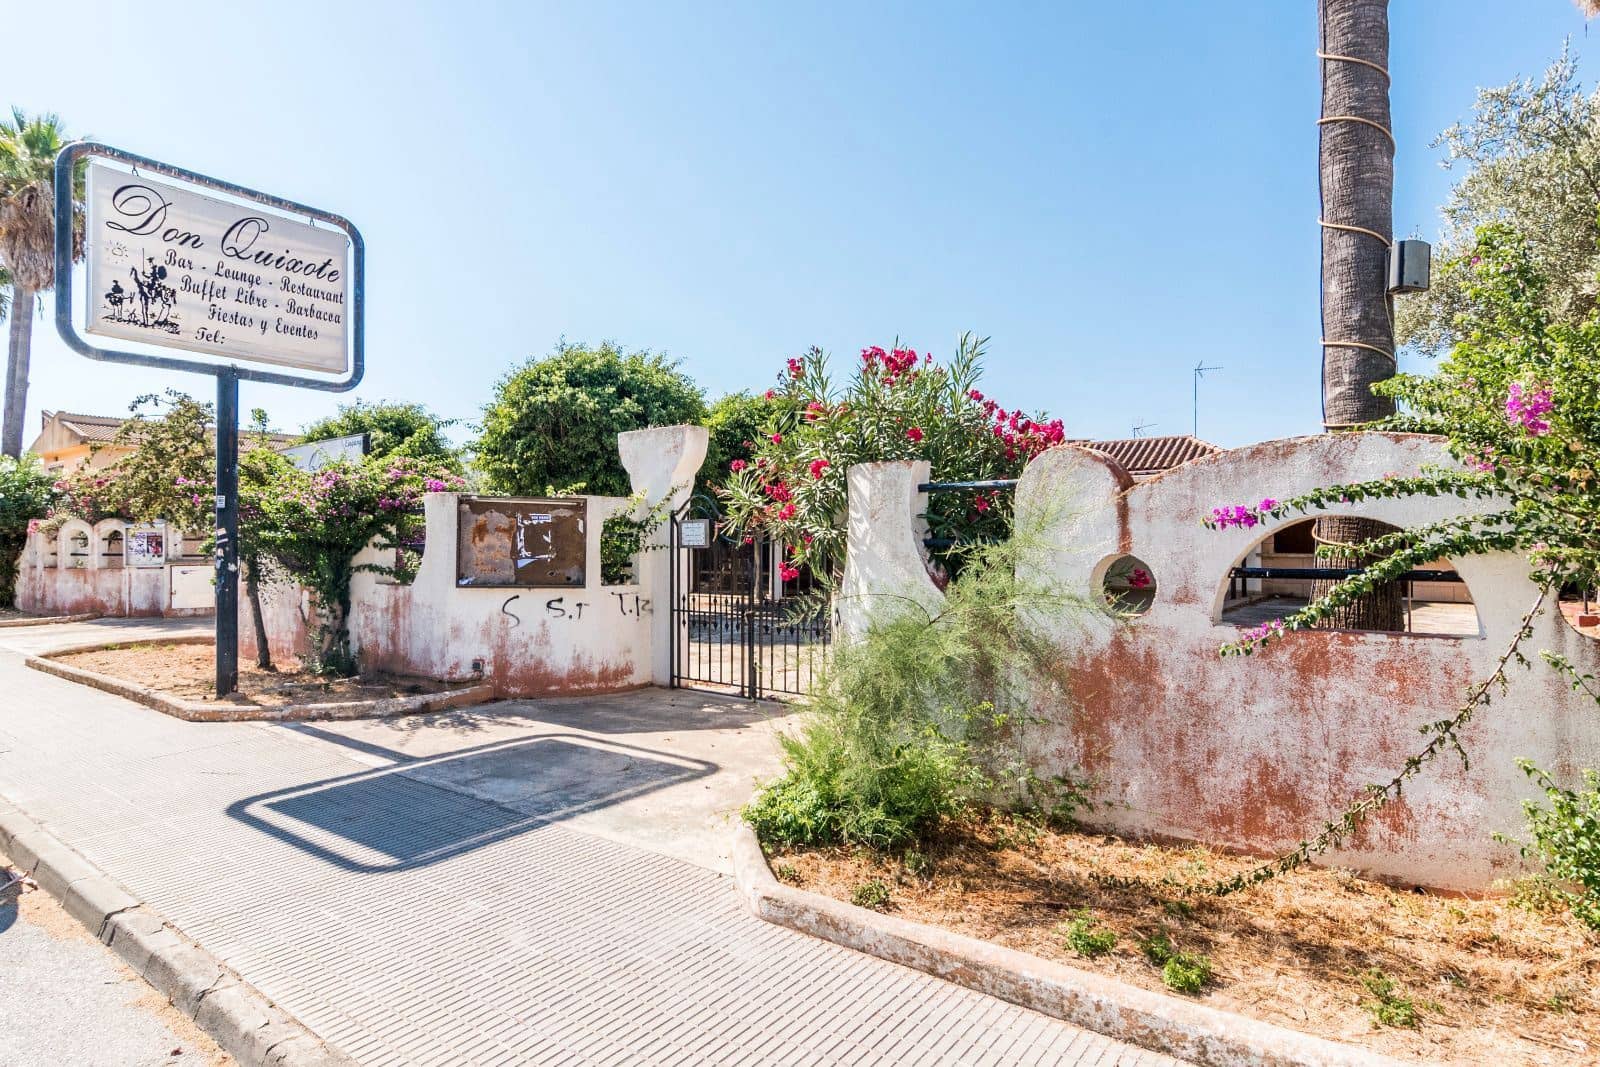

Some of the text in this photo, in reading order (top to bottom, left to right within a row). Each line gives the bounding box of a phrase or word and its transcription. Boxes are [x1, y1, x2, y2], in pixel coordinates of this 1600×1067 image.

[106, 184, 340, 283] Don Quixote
[164, 249, 193, 271] Bar
[214, 260, 262, 289] Lounge
[280, 275, 344, 305] Restaurant
[180, 274, 226, 302] Buffet
[234, 287, 268, 308] Libre
[286, 298, 341, 325] Barbacoa
[195, 326, 226, 345] Tel:
[207, 303, 319, 340] Fiestas y Eventos
